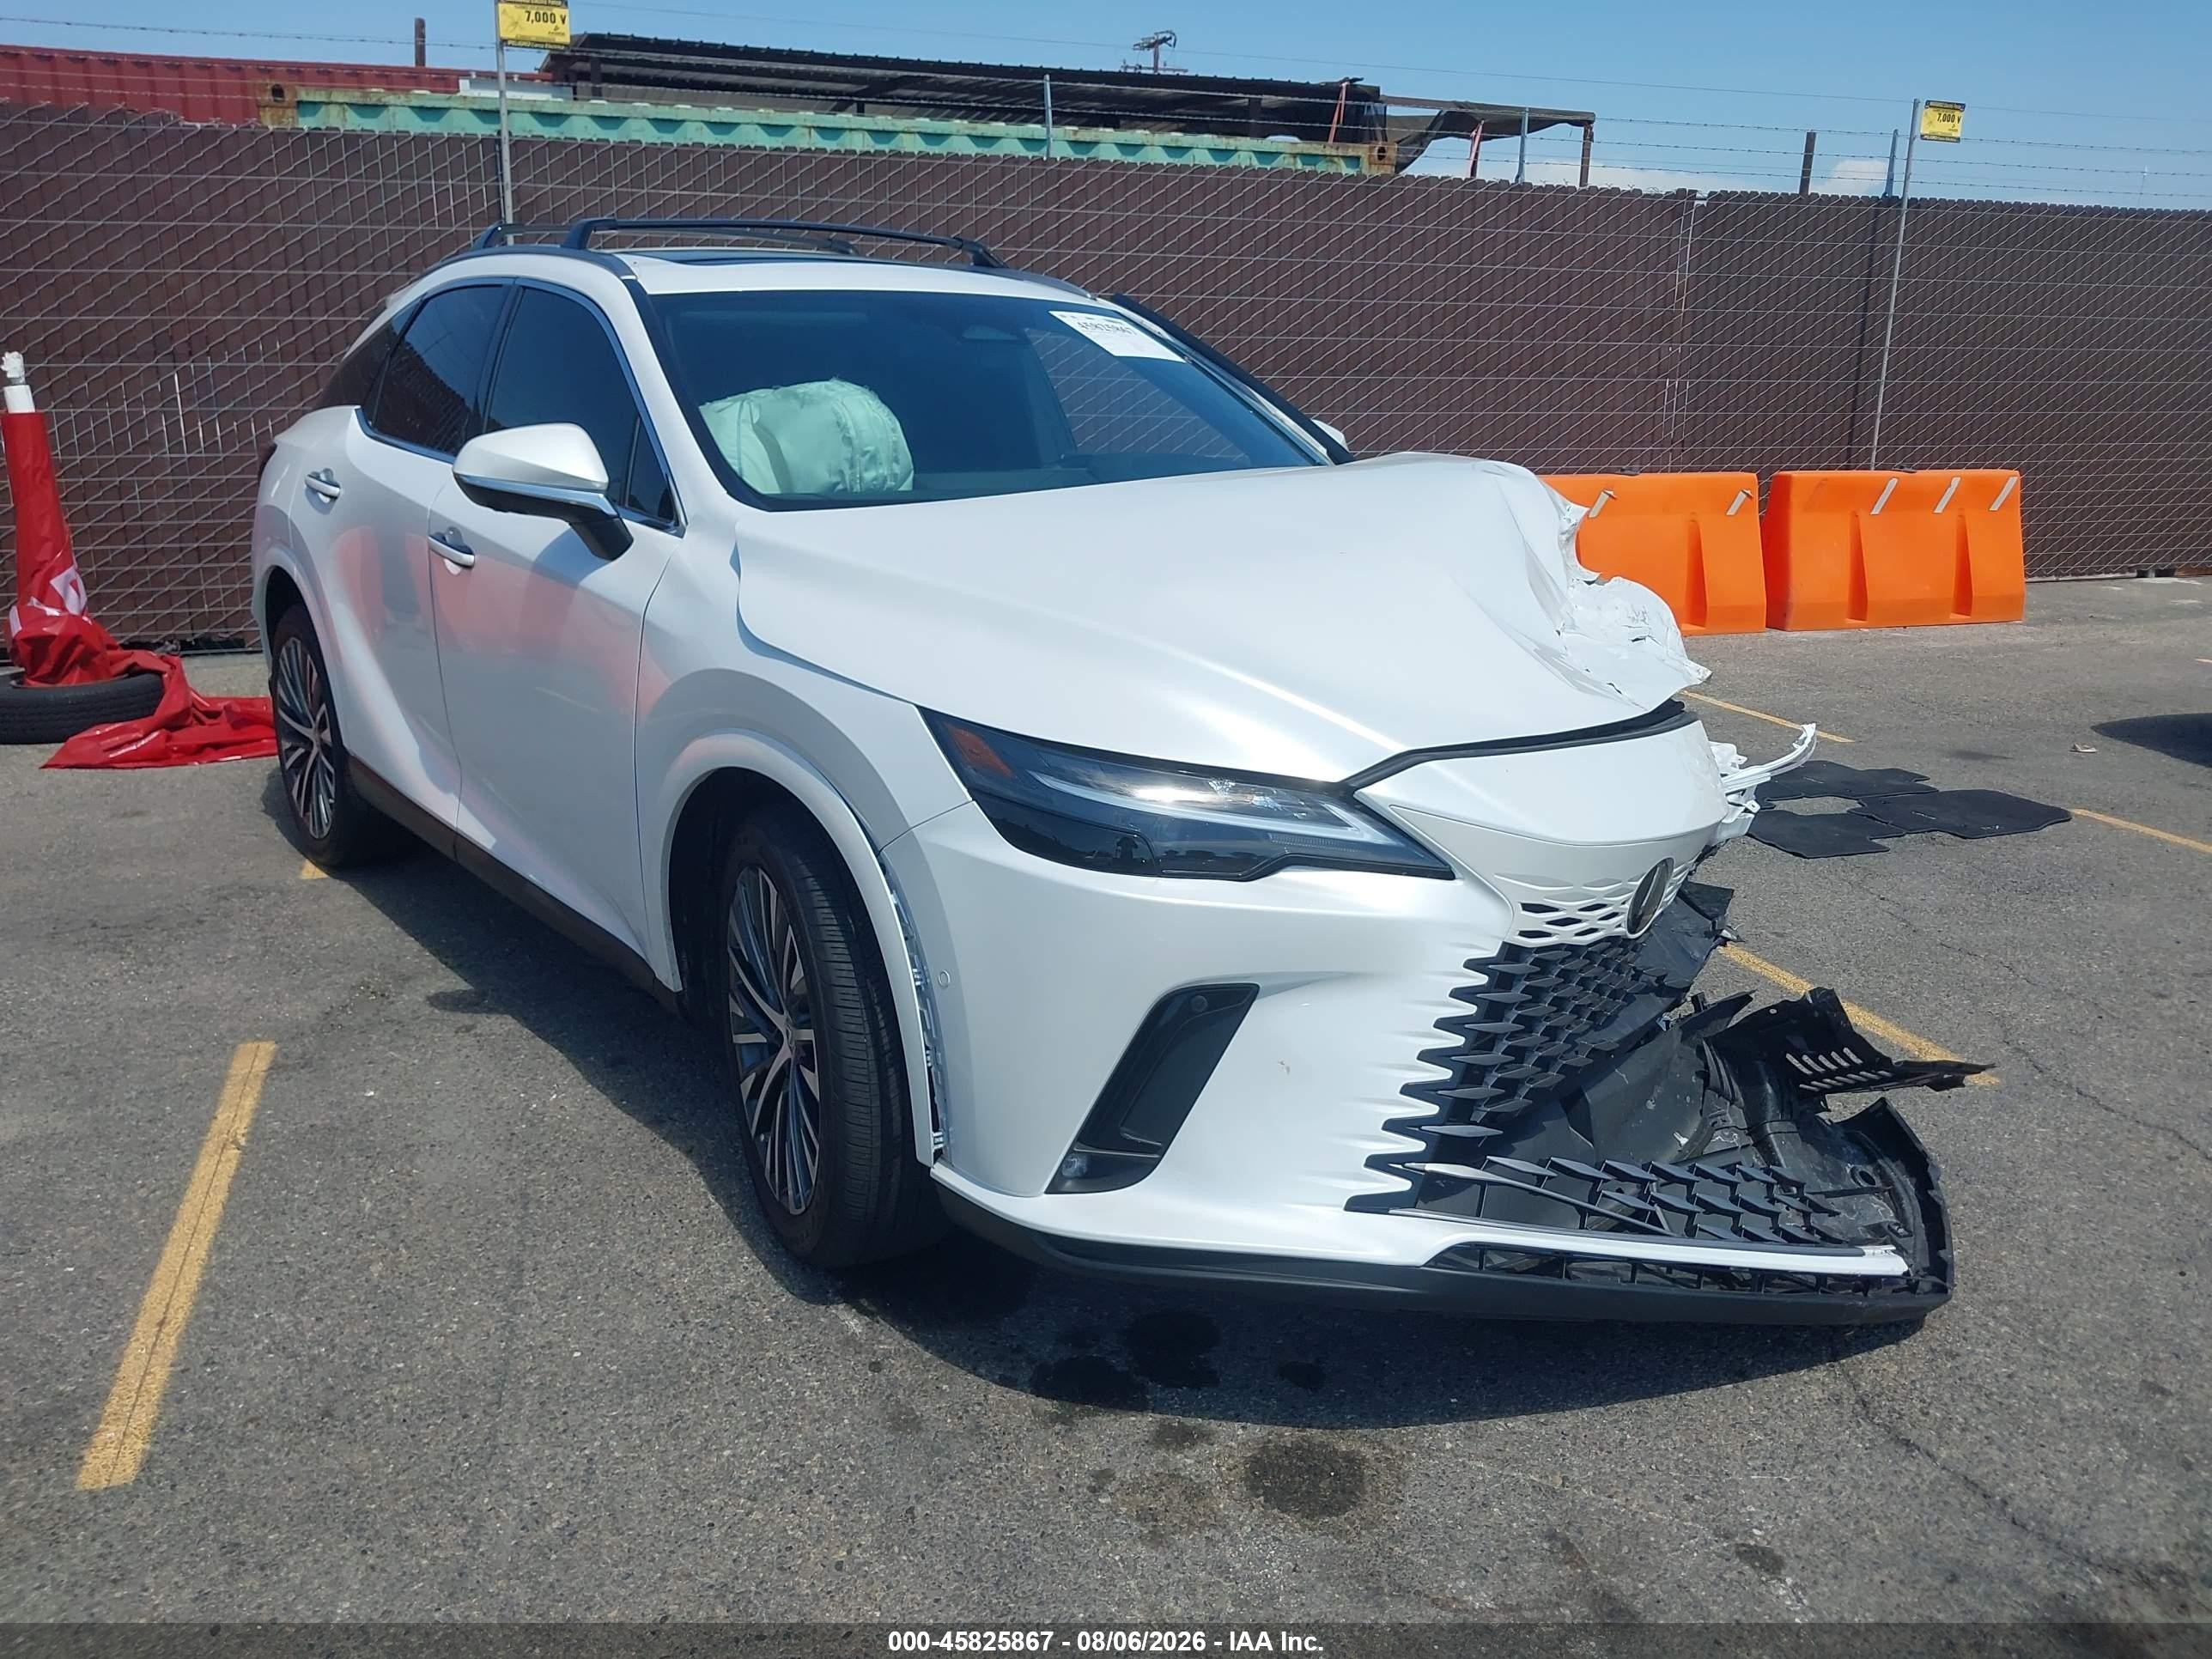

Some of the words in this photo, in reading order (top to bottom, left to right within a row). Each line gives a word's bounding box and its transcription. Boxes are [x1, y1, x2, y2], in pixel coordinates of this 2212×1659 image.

[525, 10, 556, 24] 7,000
[560, 14, 567, 25] V
[1936, 112, 1956, 123] 7,000
